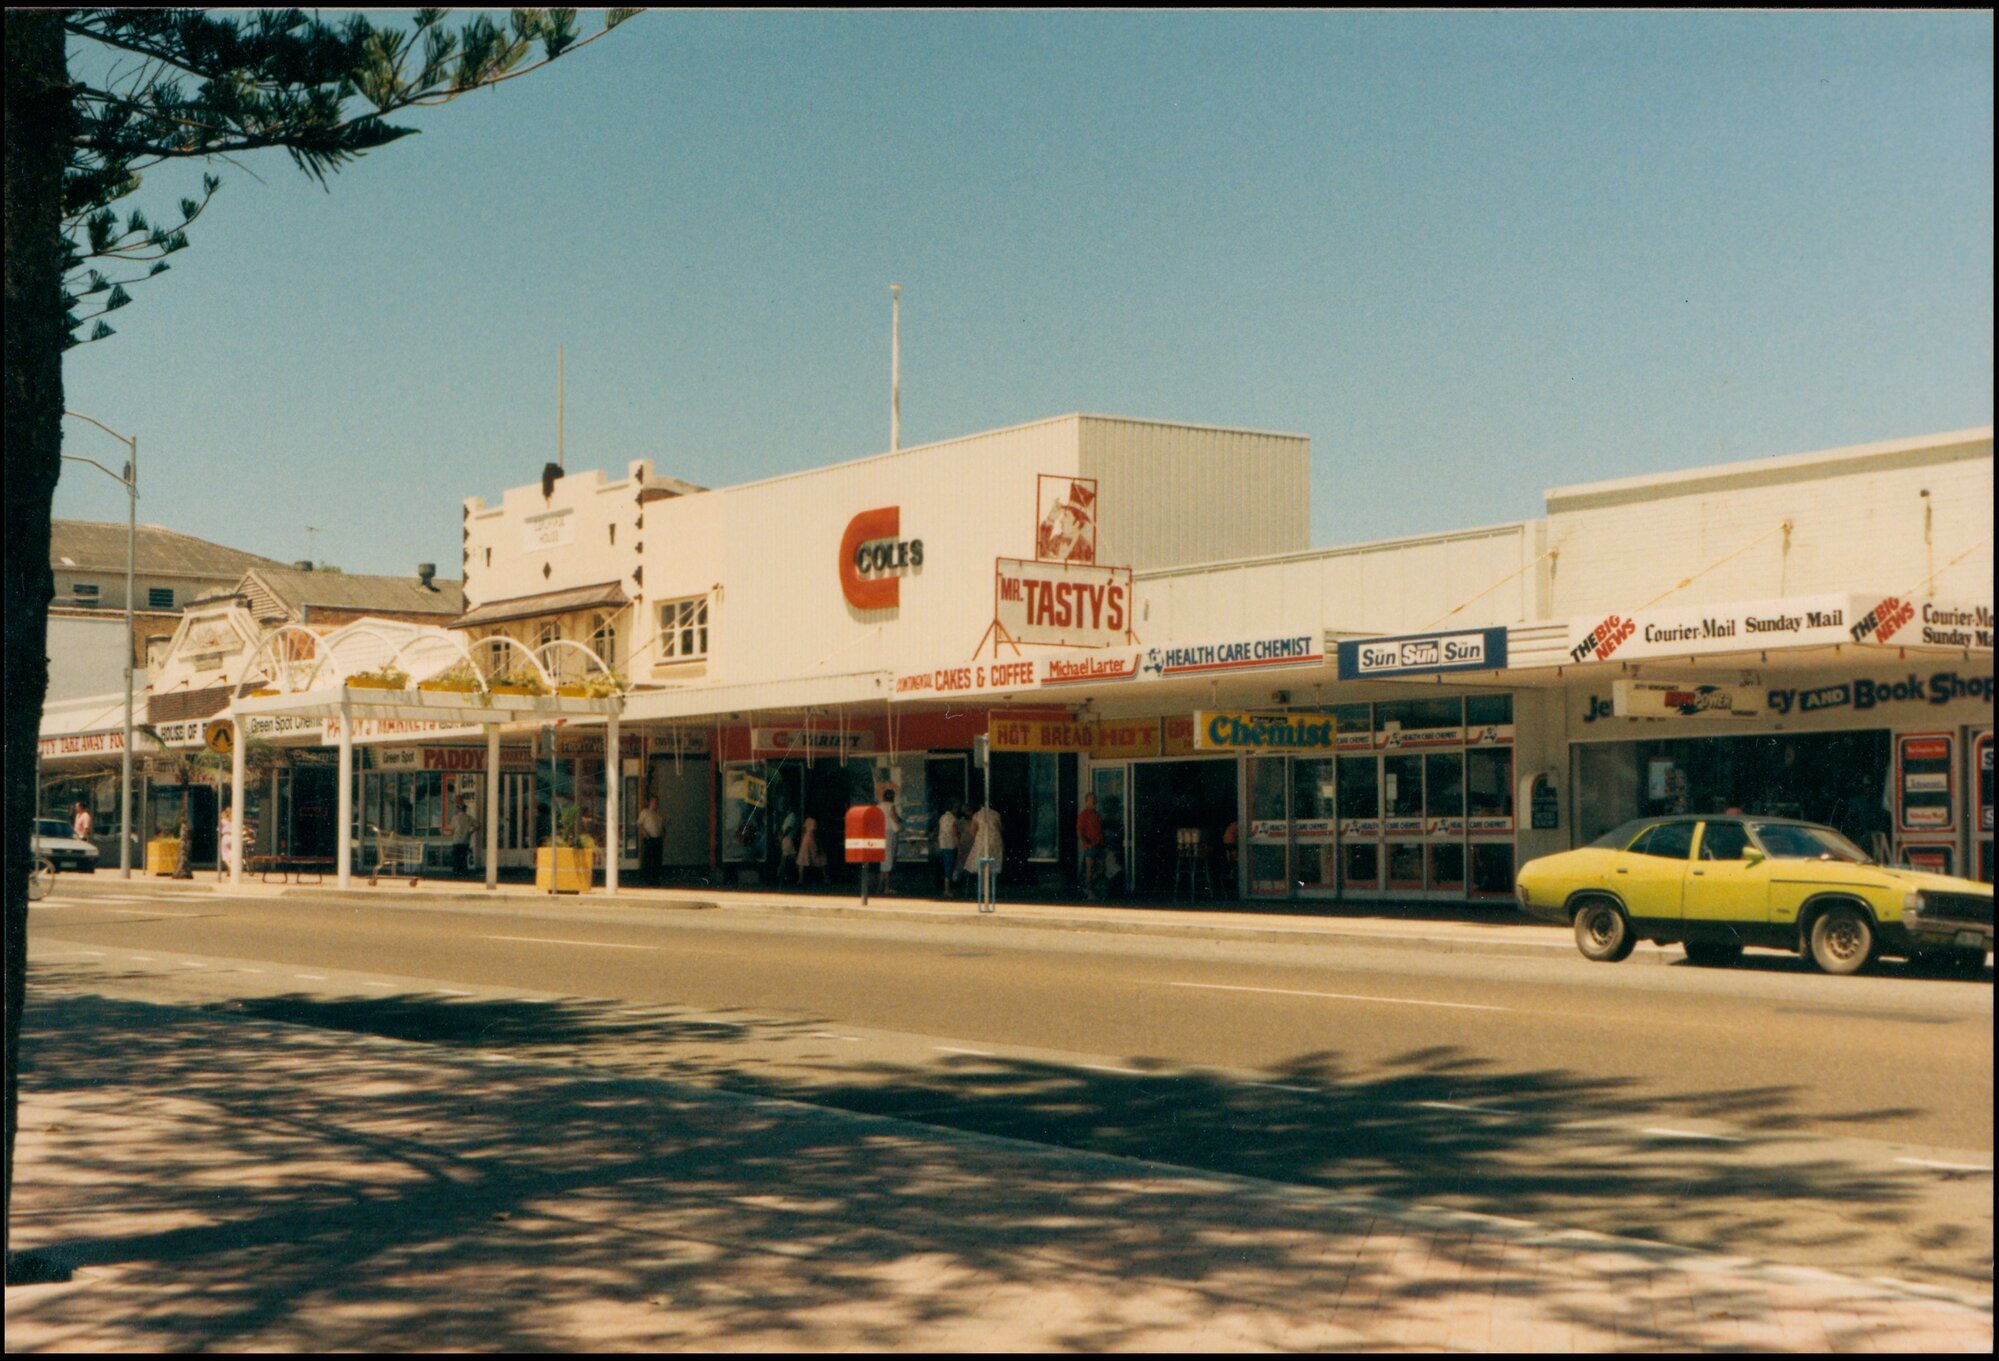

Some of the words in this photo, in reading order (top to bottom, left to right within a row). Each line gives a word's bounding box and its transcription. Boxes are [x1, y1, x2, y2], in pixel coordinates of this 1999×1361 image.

[856, 539, 924, 574] COLES
[1001, 577, 1023, 601] MR.
[1023, 578, 1123, 631] TASTY'S
[1645, 618, 1736, 643] Courier-Mail
[1745, 615, 1802, 635] Sunday
[1806, 609, 1843, 629] Mail
[1850, 615, 1879, 641] THE
[1873, 597, 1900, 620] BIG
[1876, 602, 1915, 644] NEWS
[1570, 632, 1598, 663] THE
[1593, 615, 1620, 642] BIG
[1595, 618, 1636, 661] NEWS
[1922, 626, 1972, 648] Sunday
[1166, 646, 1214, 666] HEALTH
[1217, 643, 1250, 661] CARE
[1254, 637, 1312, 658] CHEMIST
[1362, 648, 1396, 667] Sun
[1401, 643, 1438, 665] Sun
[1444, 641, 1481, 660] Sun
[935, 668, 971, 691] CAKES
[976, 666, 985, 688] &
[991, 662, 1033, 686] COFFEE
[1049, 659, 1089, 677] Michael
[1089, 657, 1125, 674] Larter
[1807, 689, 1844, 707] AND
[1854, 674, 1926, 709] Book
[160, 724, 184, 742] HOUSE
[187, 723, 198, 740] OF
[250, 717, 274, 734] Green
[275, 716, 292, 733] Spot
[997, 723, 1030, 745] HOT
[1041, 723, 1092, 746] BREAD
[1099, 726, 1153, 746] HOT
[1209, 715, 1332, 747] Chemist
[60, 736, 80, 753] TAKE
[82, 733, 106, 752] AWAY
[802, 734, 861, 747] VARIETY
[383, 751, 400, 764] Green
[401, 750, 415, 764] Spot
